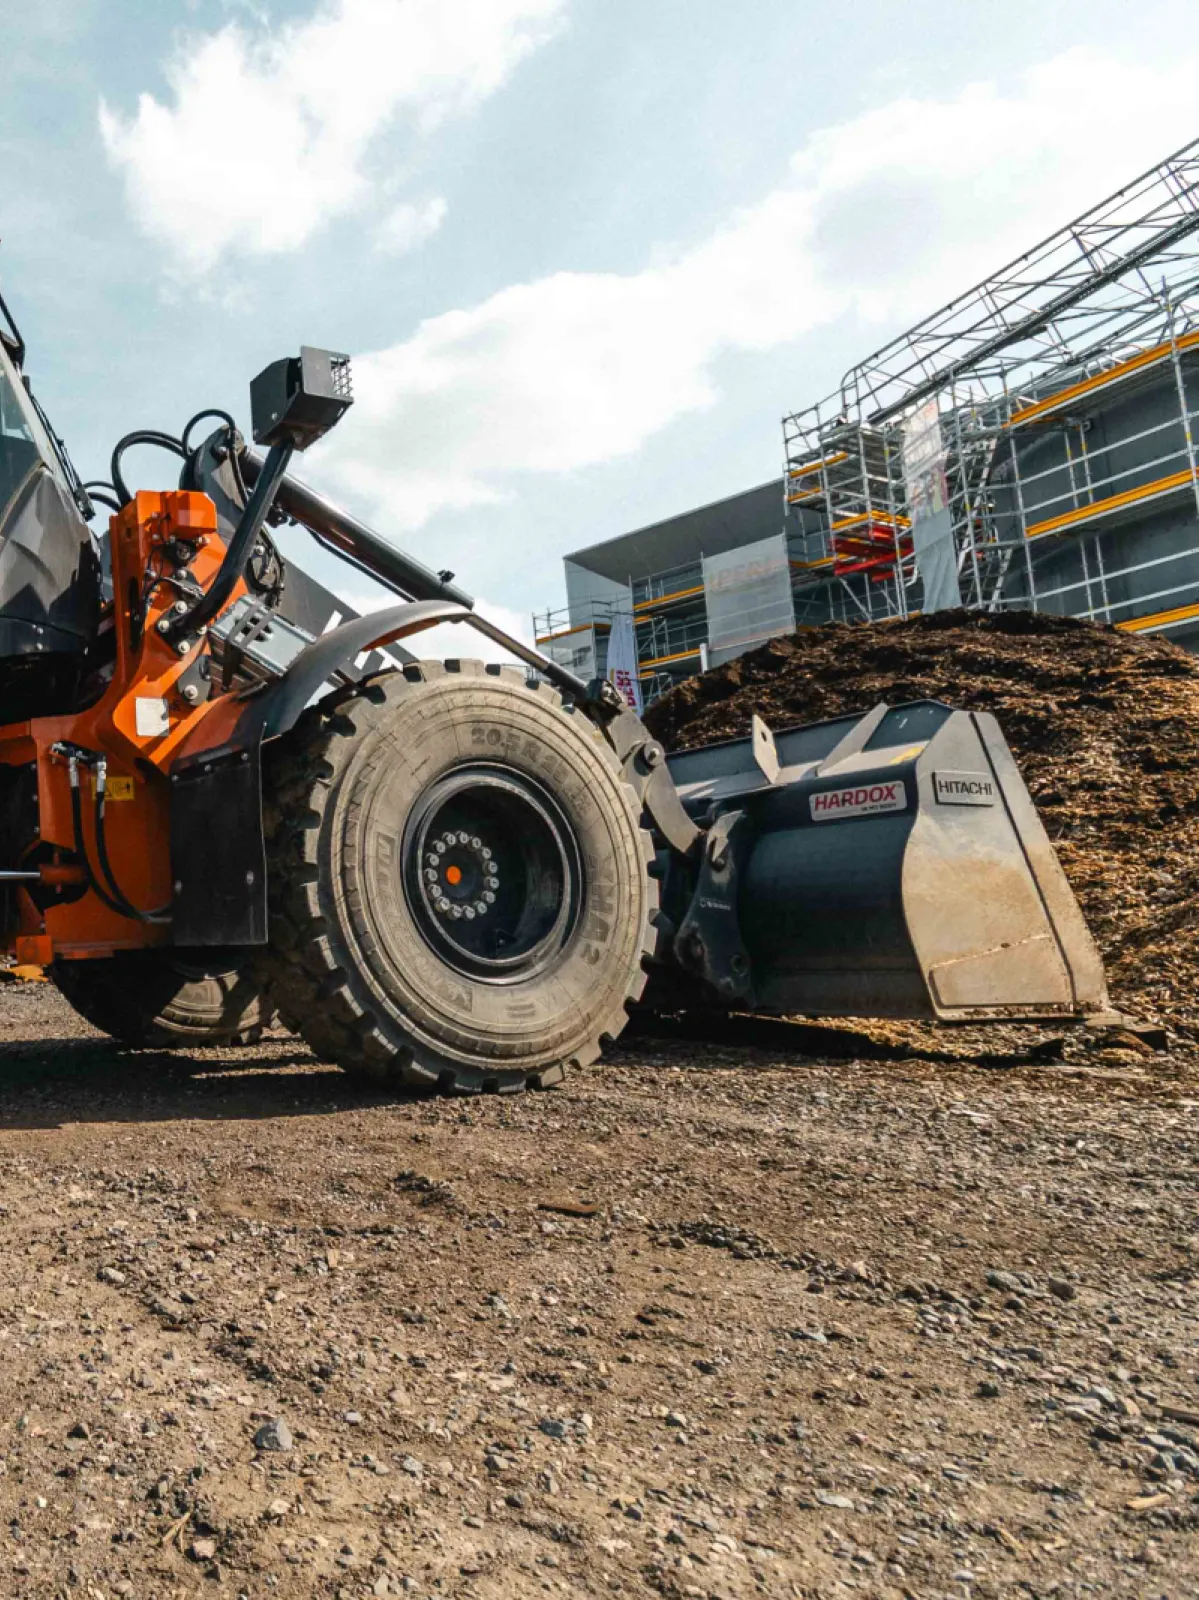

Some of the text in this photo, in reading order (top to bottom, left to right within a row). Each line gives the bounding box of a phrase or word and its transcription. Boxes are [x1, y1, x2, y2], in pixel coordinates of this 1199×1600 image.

[471, 726, 520, 752] 20.5
[814, 784, 897, 812] HARDOX
[937, 780, 993, 796] HITACHI
